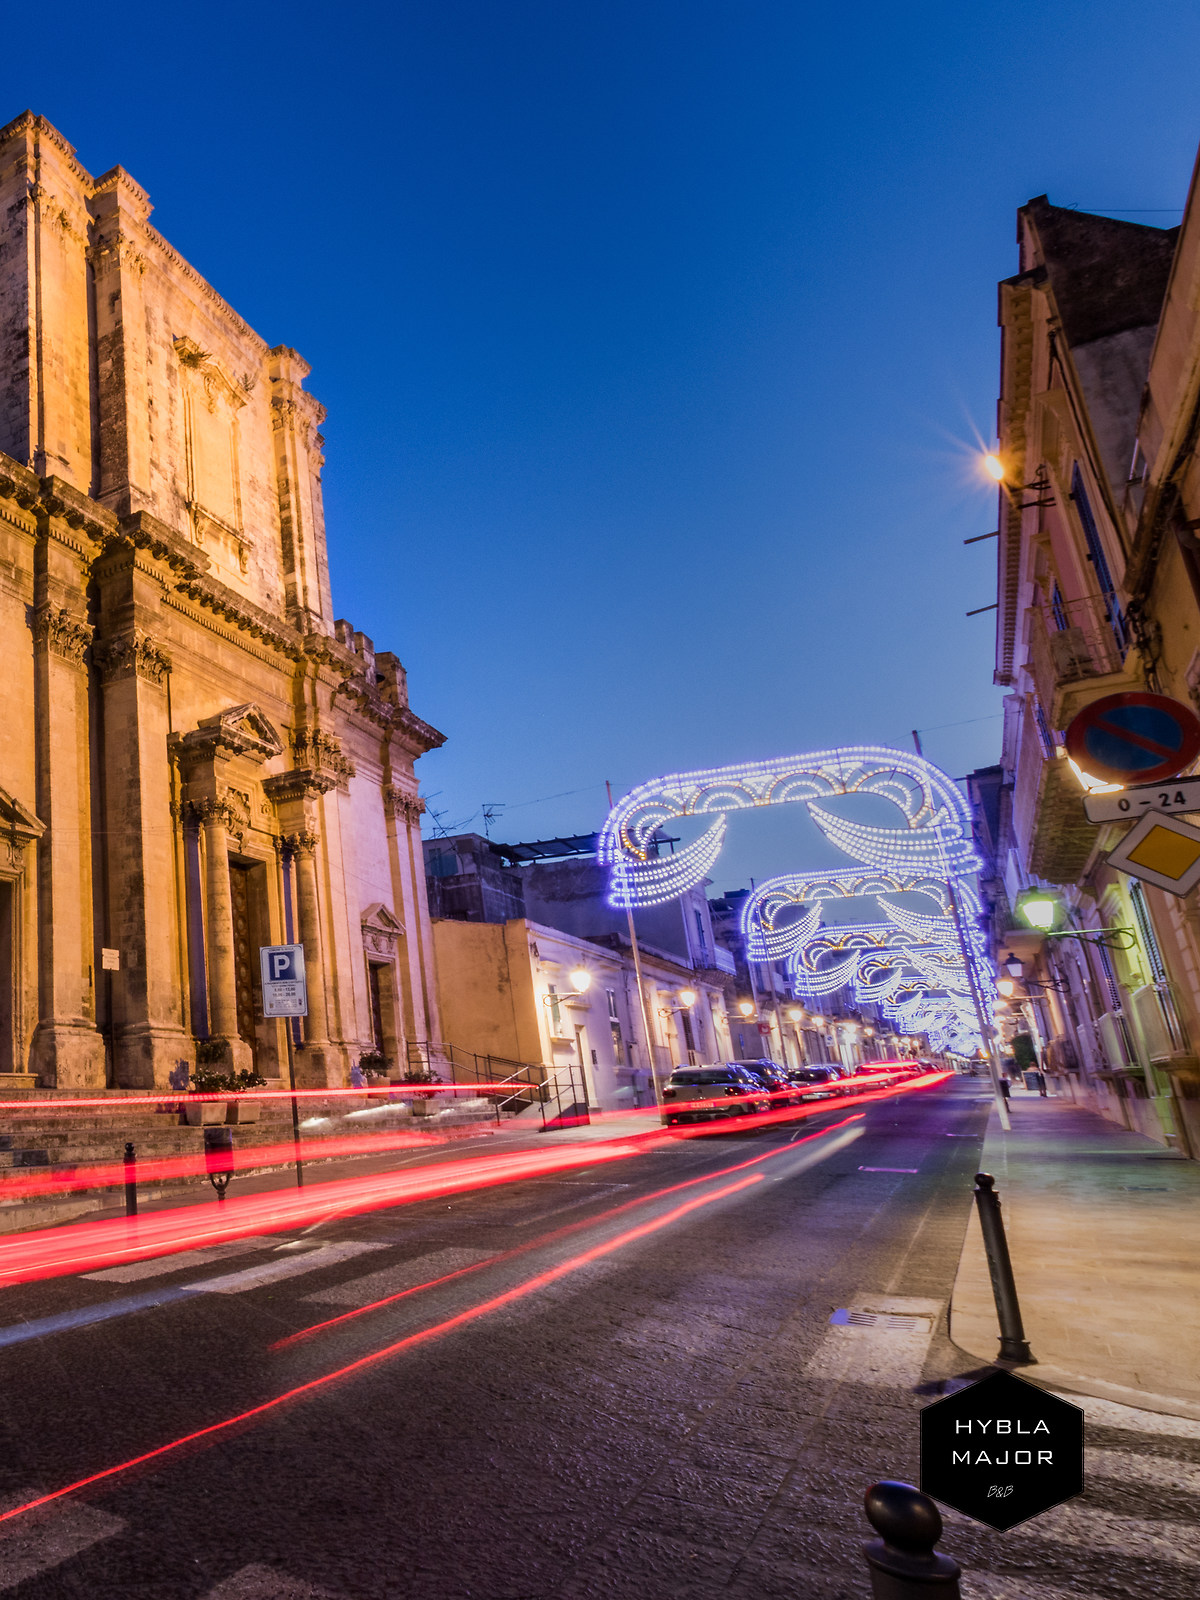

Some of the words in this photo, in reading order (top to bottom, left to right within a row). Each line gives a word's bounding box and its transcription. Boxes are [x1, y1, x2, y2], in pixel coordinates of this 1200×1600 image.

[1118, 798, 1130, 812] 0
[1158, 791, 1186, 808] 24
[273, 954, 290, 978] P
